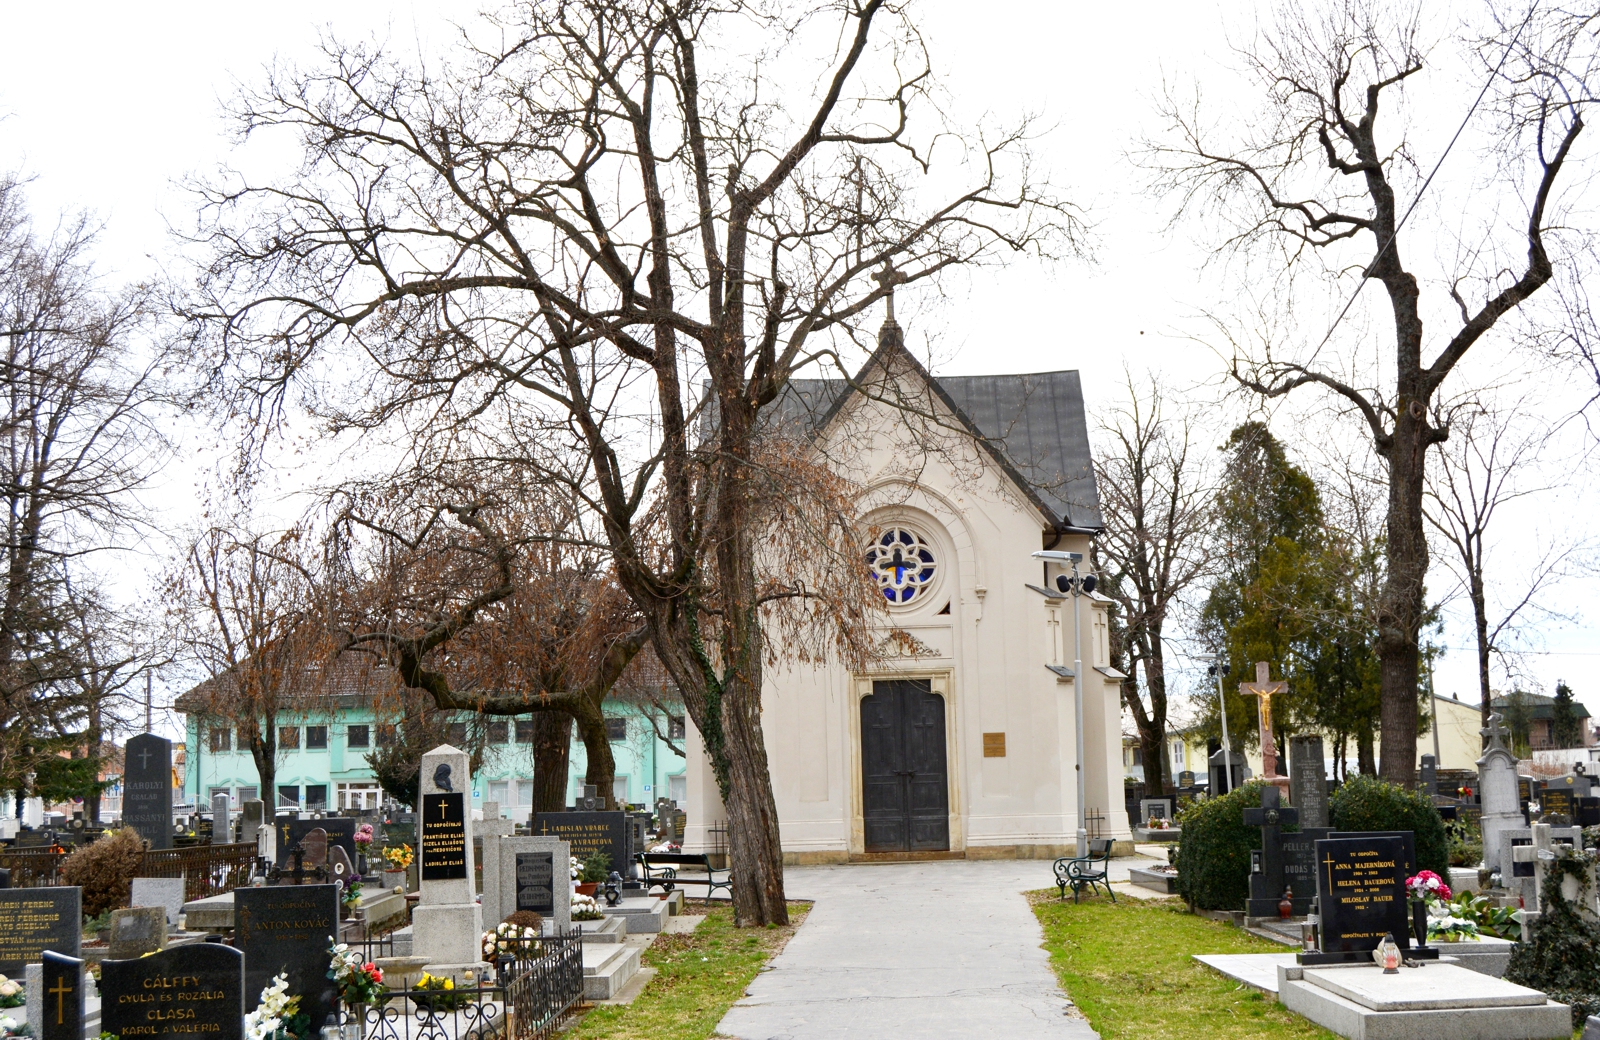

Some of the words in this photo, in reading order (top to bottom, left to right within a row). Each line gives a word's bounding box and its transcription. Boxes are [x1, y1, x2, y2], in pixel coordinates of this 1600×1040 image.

[1355, 860, 1395, 868] MAJERNÍKOVÁ
[254, 921, 291, 930] ANTON
[294, 916, 330, 929] KOVÁČ
[143, 974, 200, 988] GÁLFFY
[119, 994, 155, 1003] GYULA
[160, 992, 172, 1002] ÉS
[178, 988, 225, 1001] ROZÁLIA
[122, 1026, 158, 1035] KAROL
[172, 1022, 220, 1034] VALÉRIA
